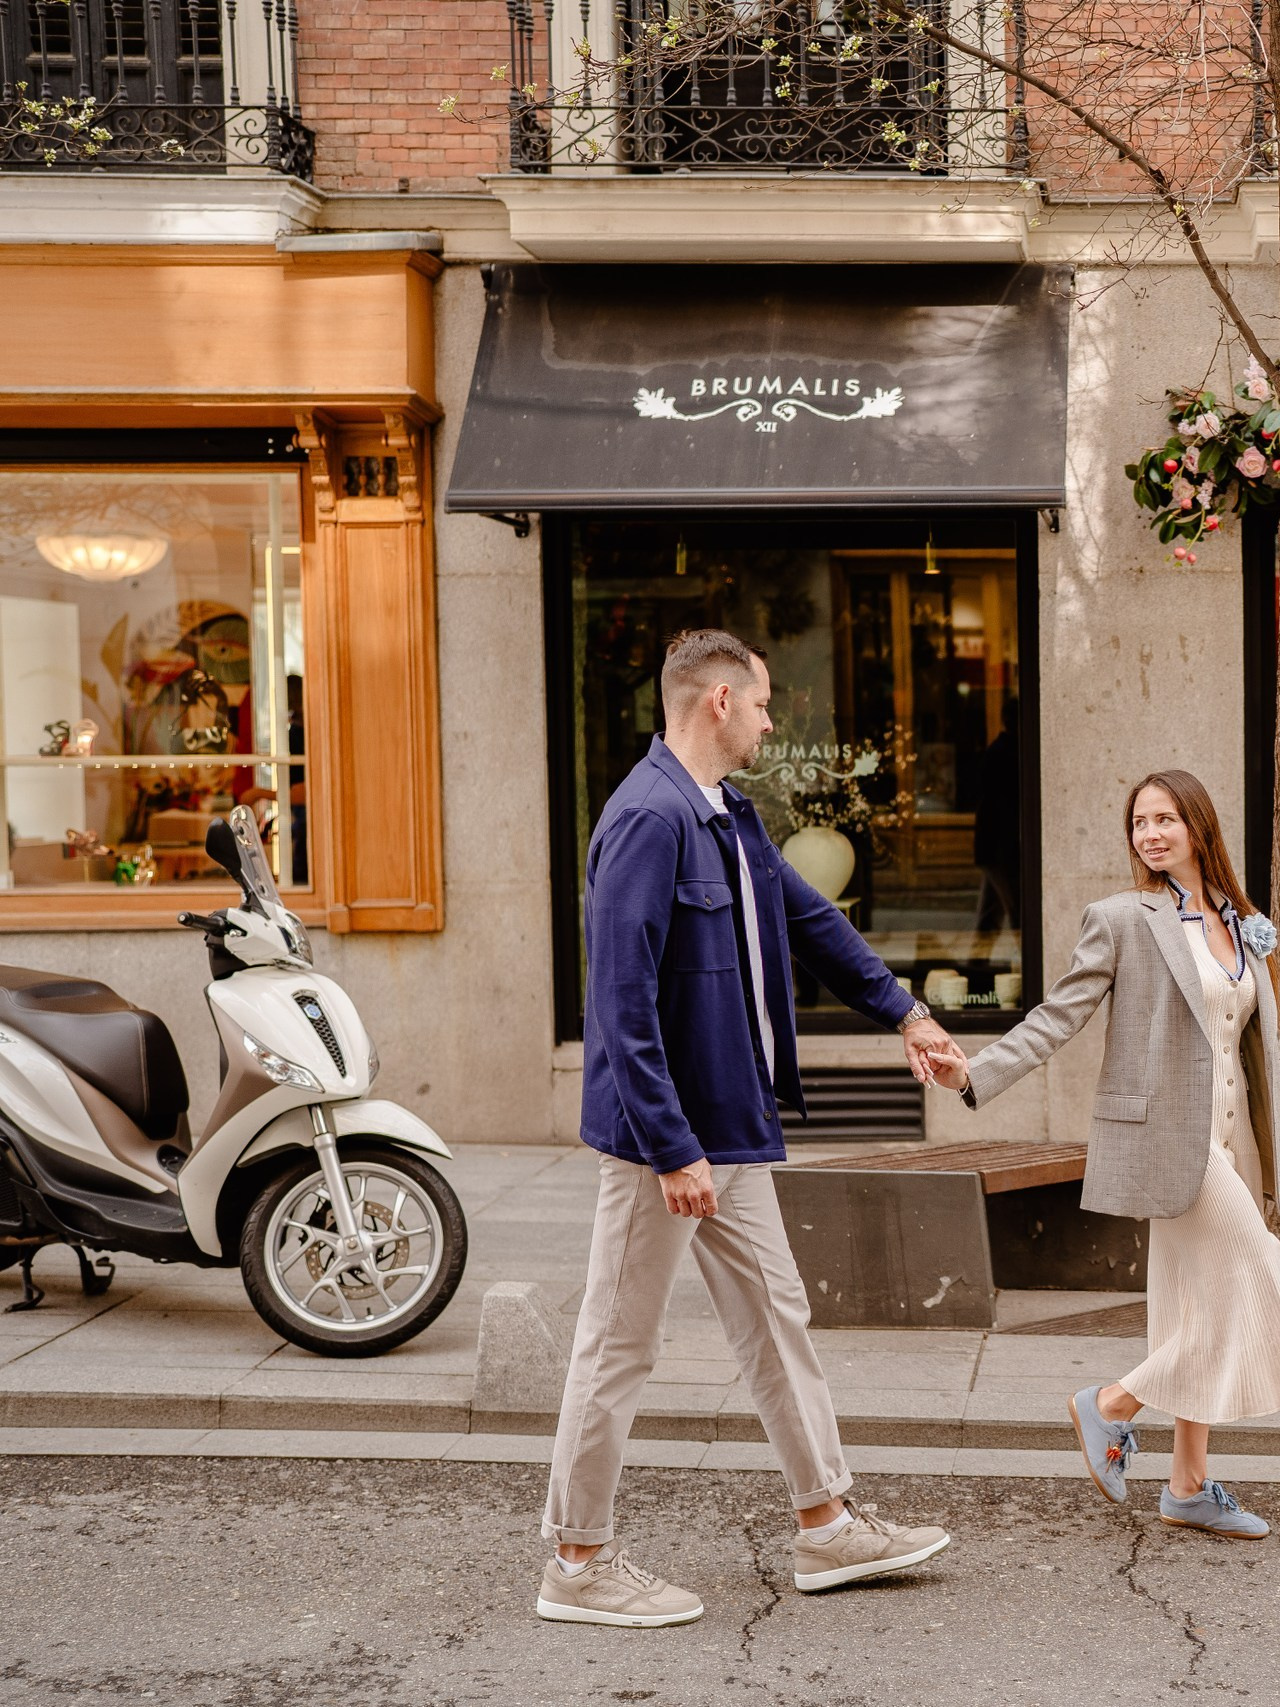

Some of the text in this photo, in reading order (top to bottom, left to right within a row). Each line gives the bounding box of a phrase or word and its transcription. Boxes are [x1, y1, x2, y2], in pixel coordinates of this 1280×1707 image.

[691, 376, 861, 396] BRUMALIS
[755, 421, 777, 433] XII
[755, 743, 852, 760] RUMALIS
